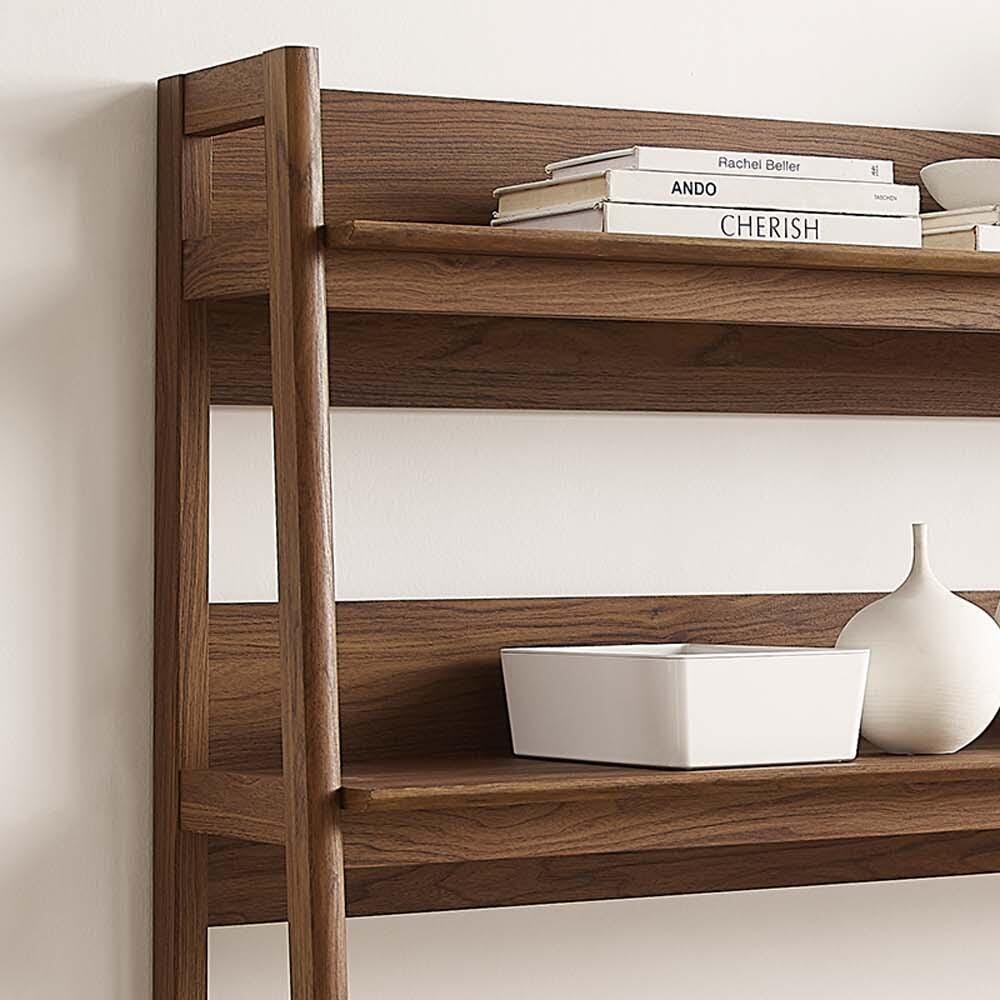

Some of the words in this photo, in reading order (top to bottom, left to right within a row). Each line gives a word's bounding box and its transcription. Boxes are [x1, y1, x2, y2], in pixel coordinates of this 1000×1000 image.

[718, 156, 762, 170] Rachel
[766, 159, 801, 172] Beller
[671, 180, 717, 197] ANDO
[720, 214, 820, 240] CHERISH
